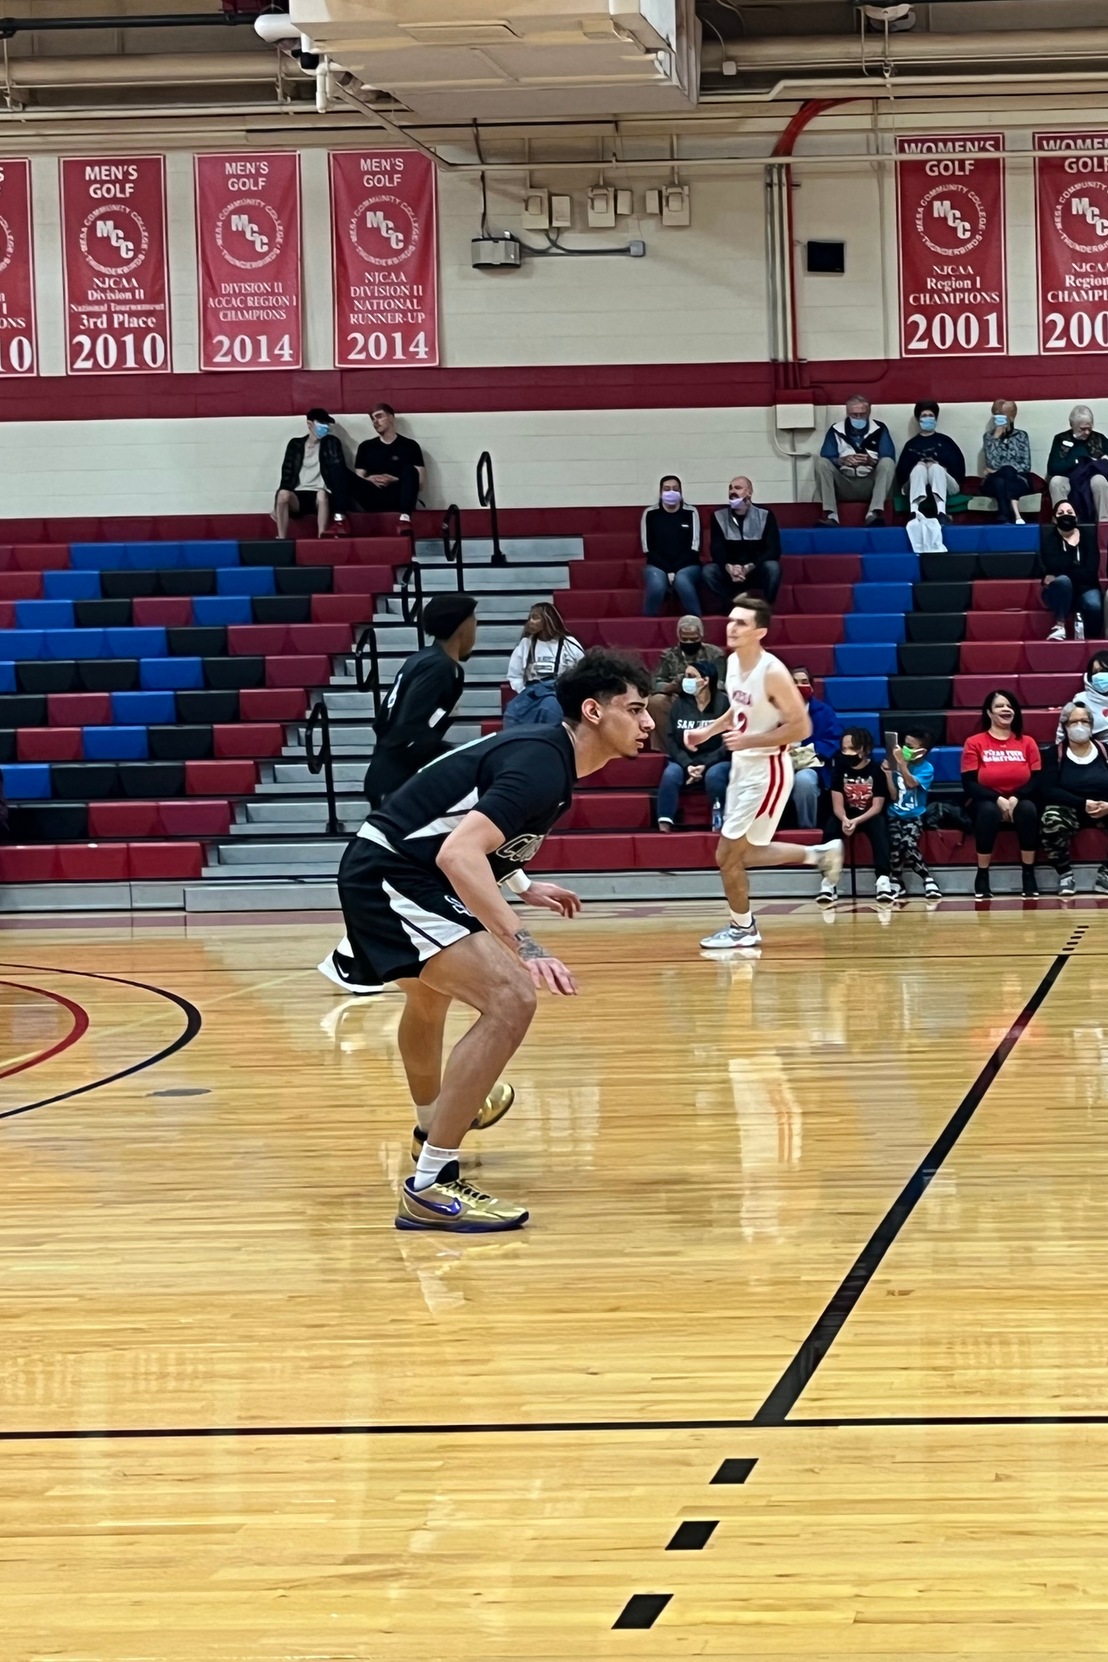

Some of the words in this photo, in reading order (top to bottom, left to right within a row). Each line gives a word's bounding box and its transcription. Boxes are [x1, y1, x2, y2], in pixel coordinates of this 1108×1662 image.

[904, 141, 995, 153] WOMEN'S
[226, 162, 269, 175] MEN'S
[361, 159, 404, 171] MEN'S
[925, 160, 975, 176] GOLF
[85, 165, 138, 180] MEN'S
[228, 178, 266, 190] GOLF
[363, 175, 401, 187] GOLF
[89, 184, 134, 198] GOLF
[1059, 182, 1107, 203] COMMUNITY
[920, 184, 968, 206] COMMUNITY
[968, 192, 986, 230] COLLEGE
[933, 200, 970, 239] MCC
[231, 214, 268, 252] MCC
[366, 211, 404, 249] MCC
[96, 220, 134, 258] MCC
[933, 266, 974, 275] NJCAA
[93, 278, 138, 288] NJCAA
[364, 272, 406, 283] NJCAA
[927, 278, 972, 291] Region
[976, 277, 980, 288] I
[88, 289, 132, 300] Division
[135, 289, 144, 299] II
[221, 283, 271, 294] DIVISION
[274, 283, 282, 293] II
[350, 286, 411, 297] DIVISION
[413, 285, 423, 296] II
[207, 297, 245, 308] ACCAC
[247, 296, 290, 307] REGION
[293, 296, 297, 306] I
[353, 299, 421, 310] NATIONAL
[909, 292, 999, 306] CHAMPIONS
[71, 304, 107, 312] National
[80, 315, 107, 329] 3rd
[114, 313, 156, 328] Place
[219, 310, 286, 321] CHAMPIONS
[350, 313, 425, 324] RUNNER-UP
[907, 312, 1002, 350] 2001
[72, 333, 165, 369] 2010
[212, 334, 293, 363] 2014
[347, 331, 428, 360] 2014
[676, 719, 695, 728] SAN
